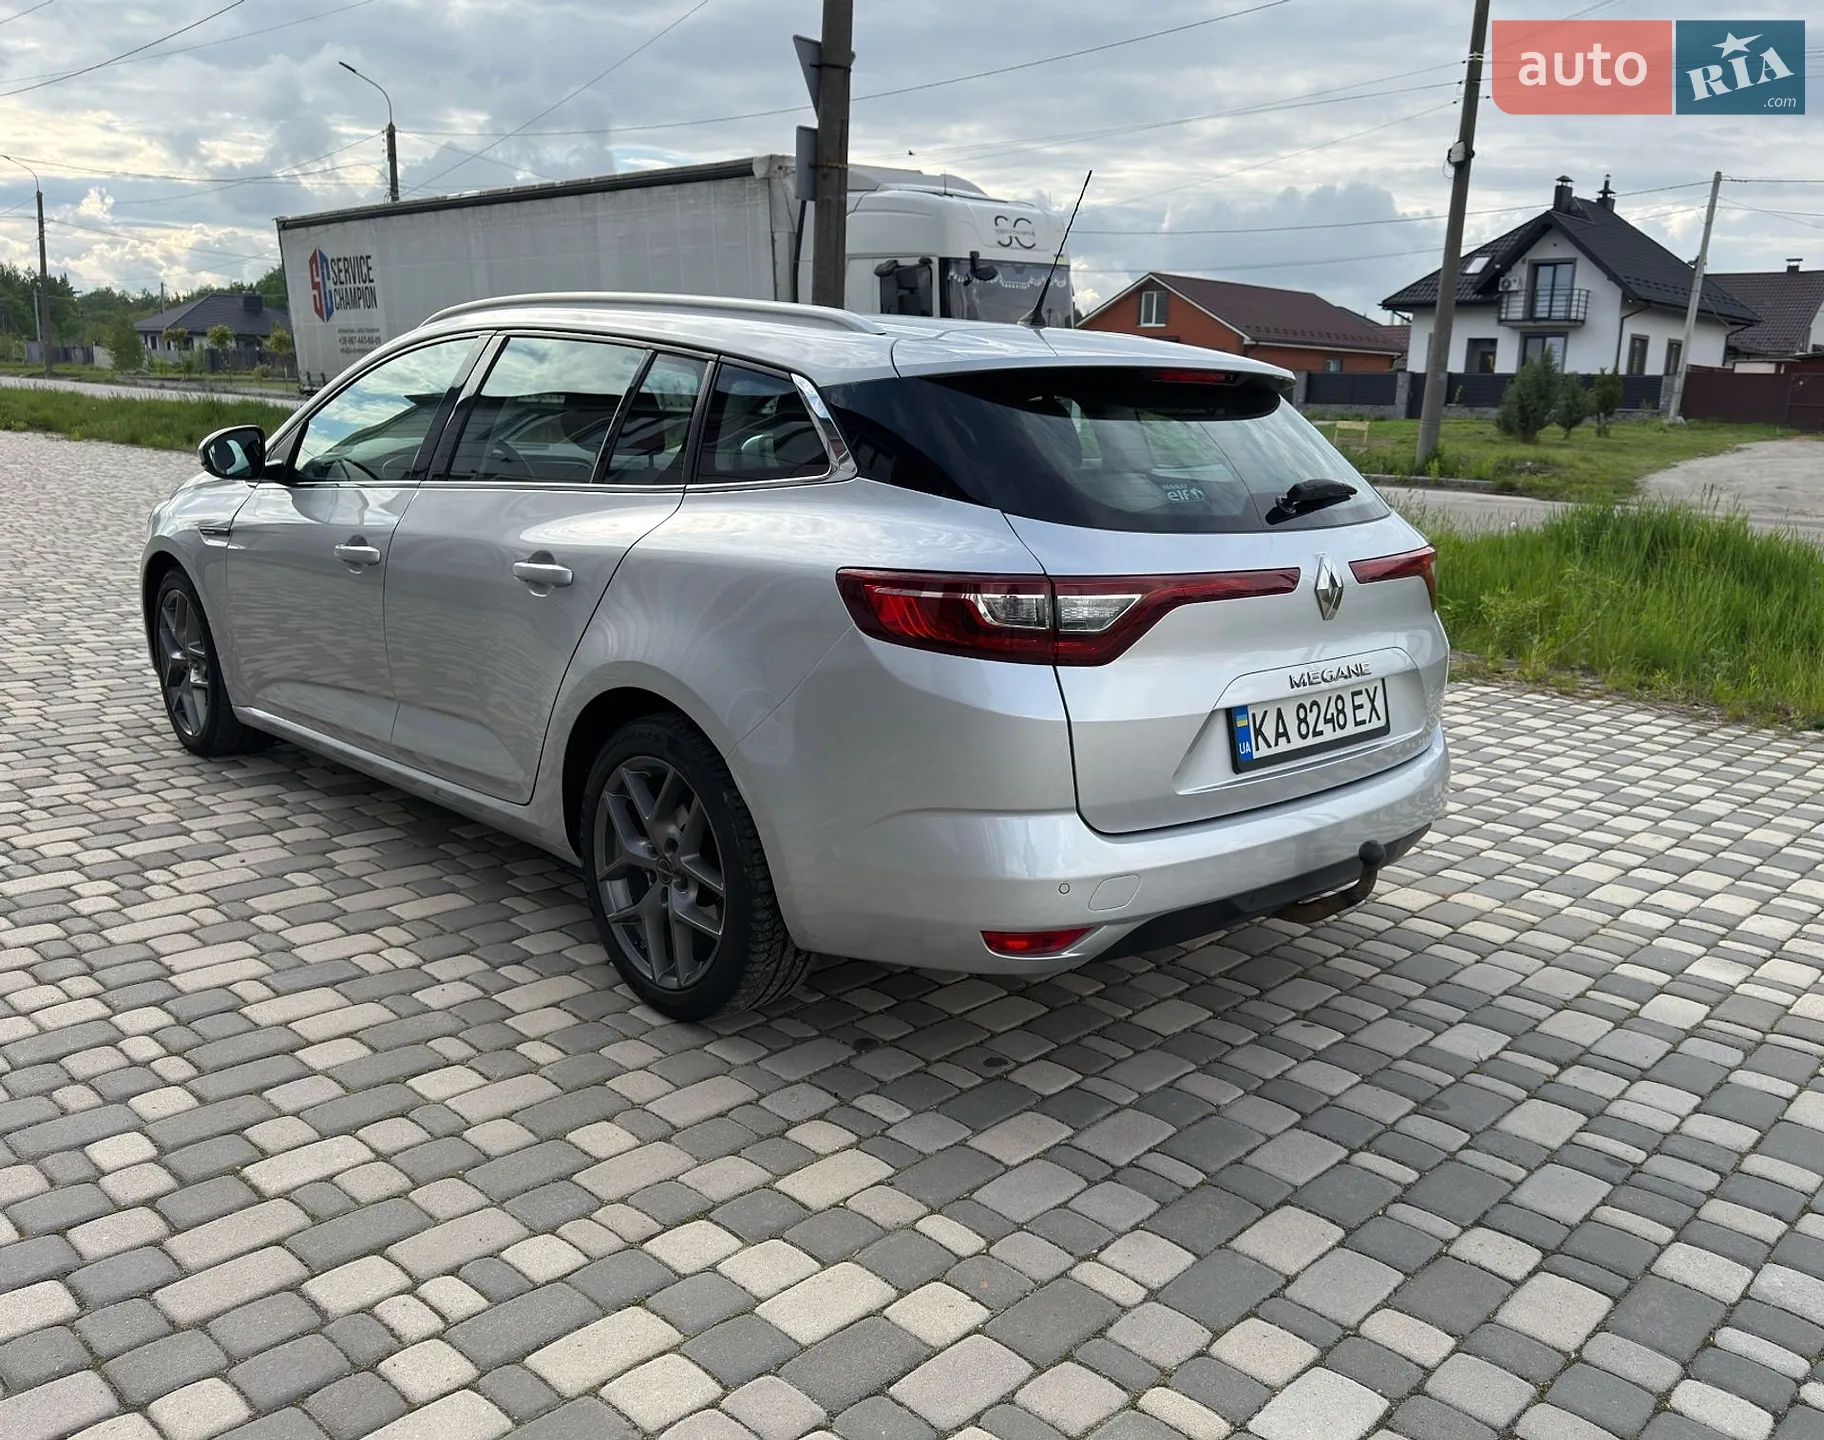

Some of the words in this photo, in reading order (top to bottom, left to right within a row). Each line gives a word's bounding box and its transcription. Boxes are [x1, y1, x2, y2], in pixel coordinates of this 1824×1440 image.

[330, 255, 374, 286] SERVICE
[333, 286, 378, 311] CHAMPION
[1289, 663, 1372, 690] MEGANE
[1251, 707, 1292, 751] KA
[1296, 694, 1347, 740] 8248
[1351, 686, 1382, 727] EX
[1239, 741, 1252, 755] UA
